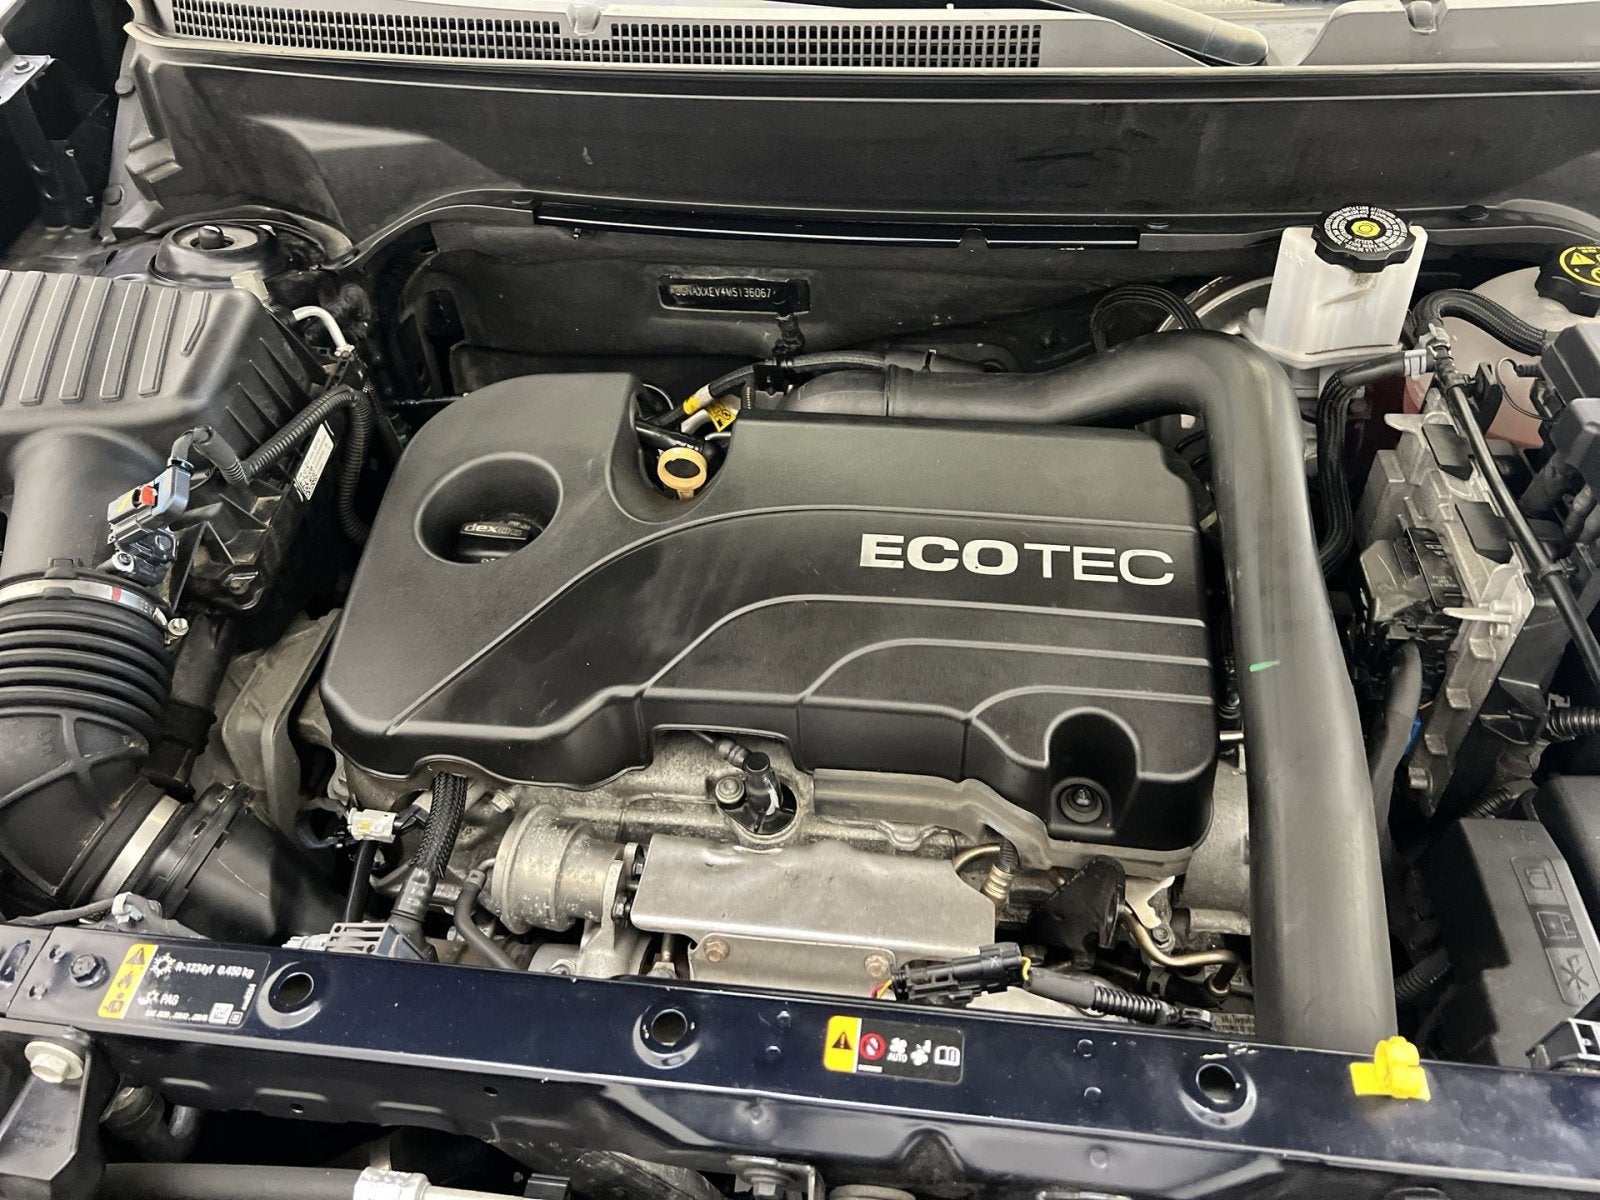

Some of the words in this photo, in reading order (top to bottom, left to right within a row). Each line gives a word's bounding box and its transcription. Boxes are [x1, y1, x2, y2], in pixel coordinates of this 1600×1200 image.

[860, 533, 1174, 586] ECOTEC
[242, 967, 255, 980] kg
[887, 1052, 908, 1063] AUTO
